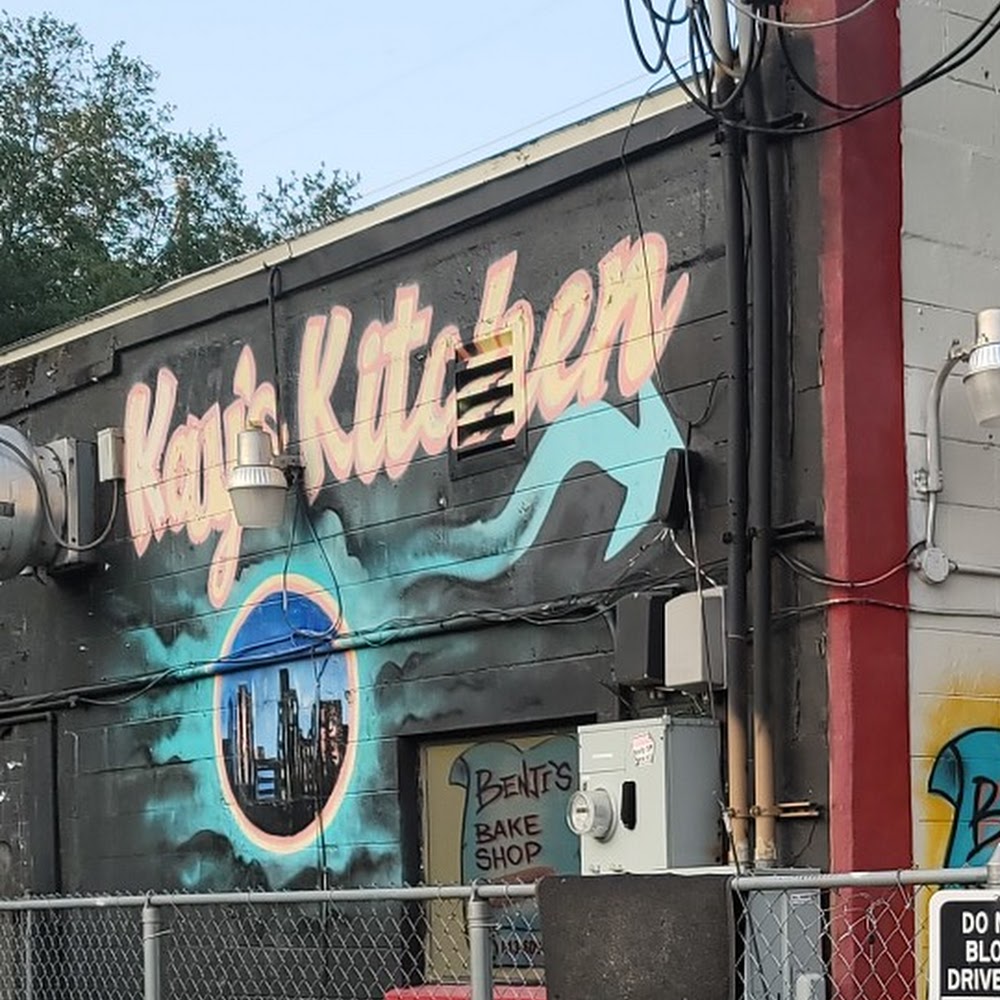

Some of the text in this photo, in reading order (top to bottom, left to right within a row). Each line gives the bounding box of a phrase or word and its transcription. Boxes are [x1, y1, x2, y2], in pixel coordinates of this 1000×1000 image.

[300, 231, 691, 505] Kitchen
[475, 813, 543, 844] BAKE
[474, 840, 543, 871] SHOP
[961, 911, 989, 935] DO
